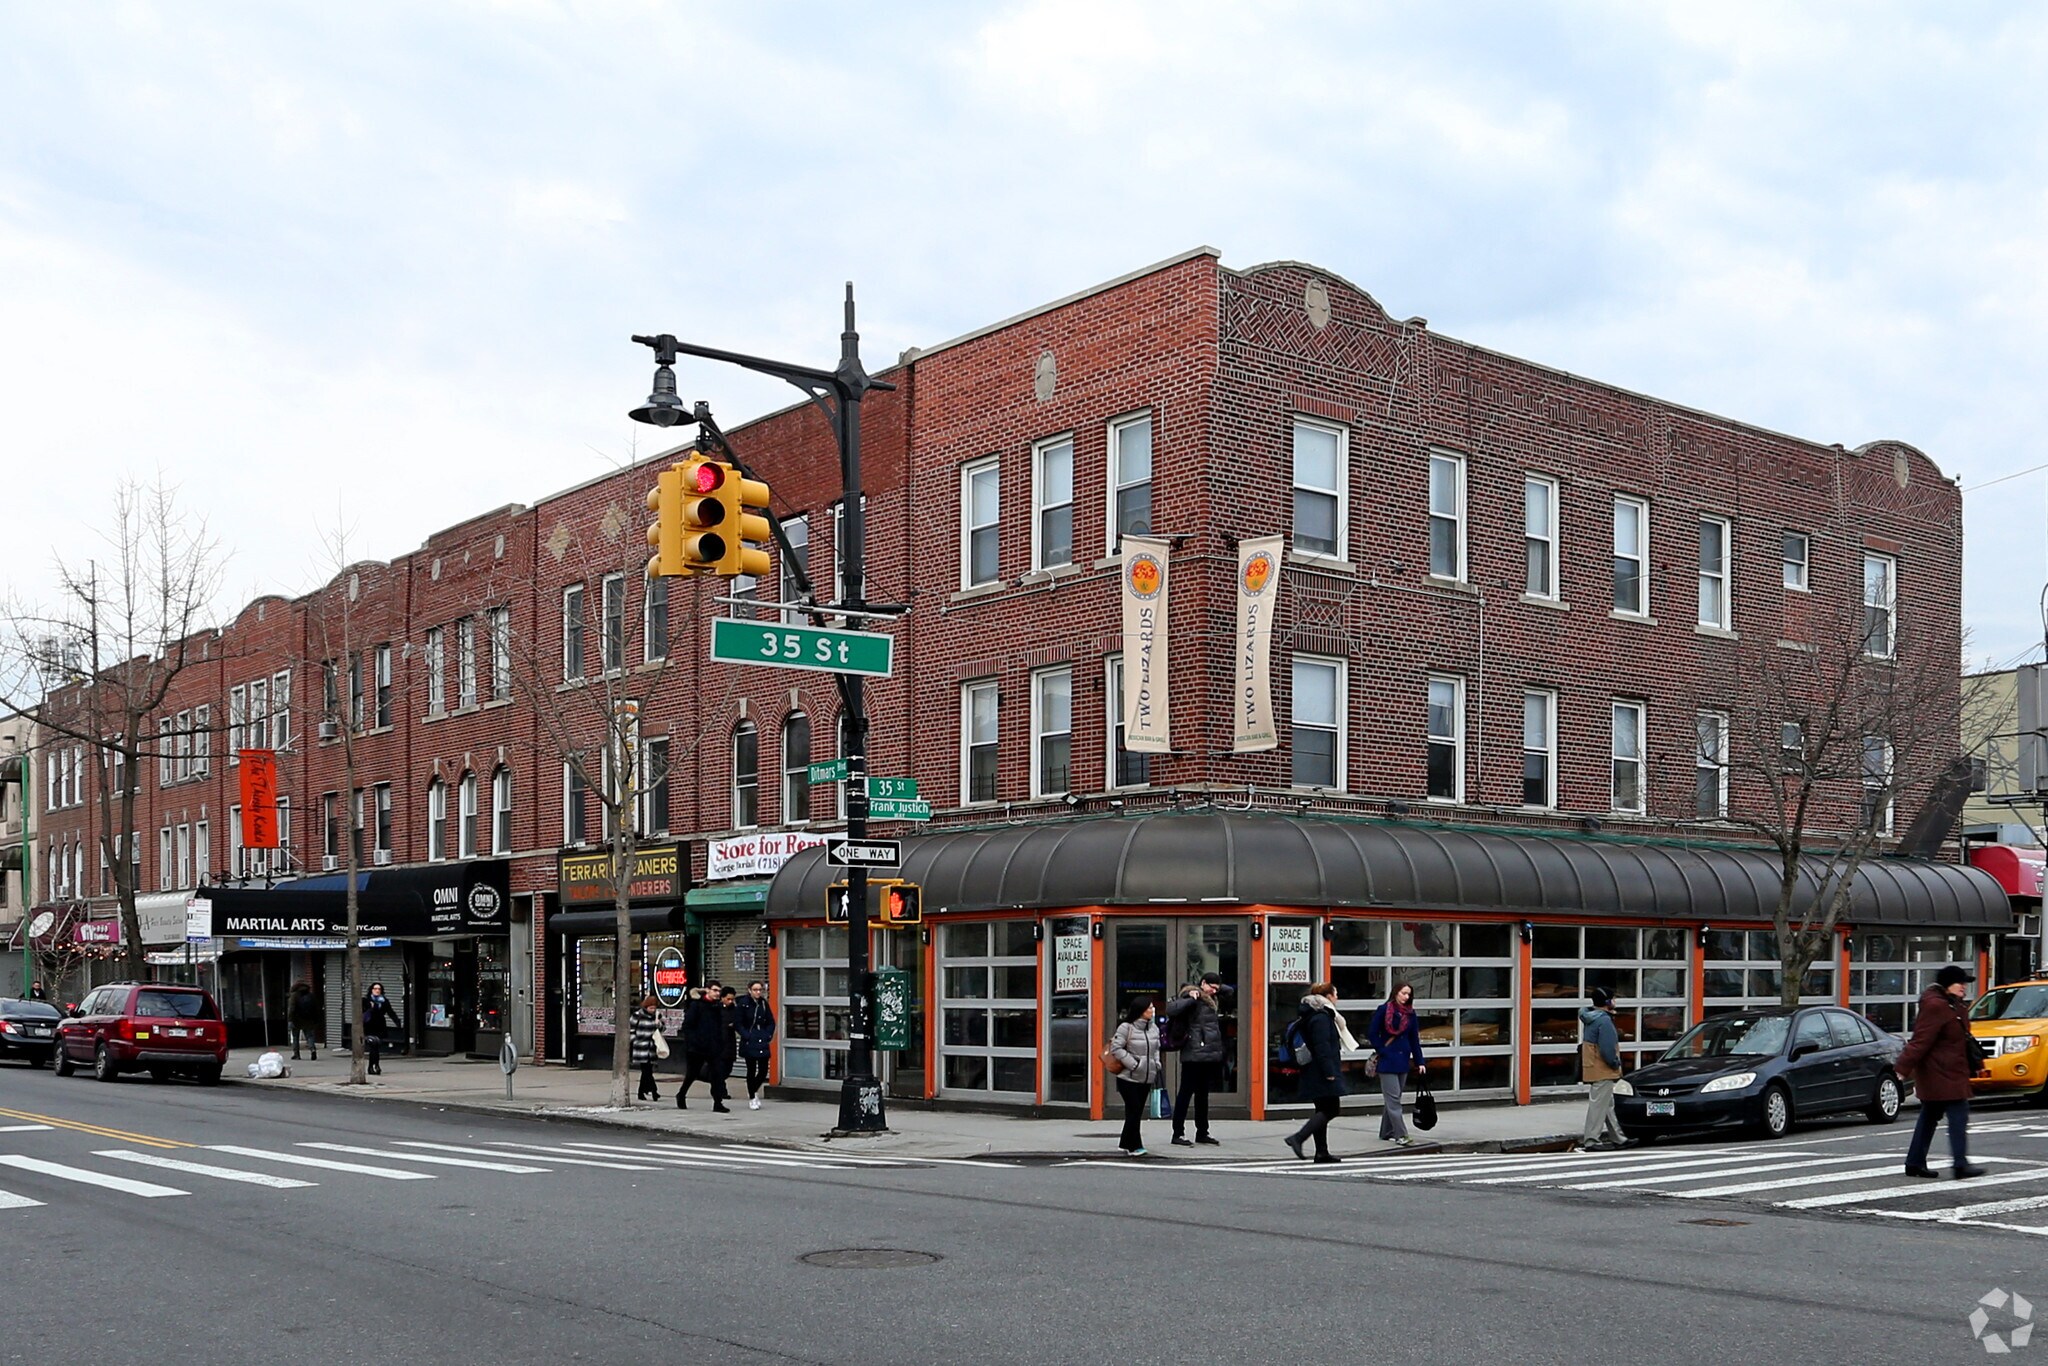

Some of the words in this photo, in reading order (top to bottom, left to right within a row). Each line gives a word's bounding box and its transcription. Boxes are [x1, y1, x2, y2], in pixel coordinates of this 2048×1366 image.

[760, 632, 801, 659] 35
[815, 637, 849, 664] St
[1140, 608, 1153, 684] LIZARDS
[1245, 604, 1259, 681] LIZARDS
[1139, 691, 1151, 730] TWO
[1245, 687, 1256, 729] TWO
[811, 767, 835, 782] Ditmars
[879, 781, 893, 796] 35
[897, 782, 905, 791] St
[870, 801, 895, 812] Frank
[898, 802, 929, 814] Justich
[716, 842, 755, 861] Store
[758, 835, 782, 855] for
[839, 848, 860, 858] ONE
[869, 850, 891, 859] WAY
[562, 859, 608, 882] FERRARI
[612, 855, 677, 878] CANERS
[433, 887, 458, 905] OMNI
[474, 894, 494, 903] OMNI
[226, 917, 288, 931] MARTIAL
[291, 918, 325, 931] ARTS
[1279, 928, 1301, 940] SPACE
[1062, 938, 1082, 949] SPACE
[1272, 942, 1309, 953] AVAILABLE
[1057, 951, 1088, 962] AVAILABLE
[1282, 957, 1296, 968] 917
[1066, 965, 1078, 975] 917
[1272, 970, 1307, 981] 617-6569
[1058, 977, 1087, 989] 617-6569
